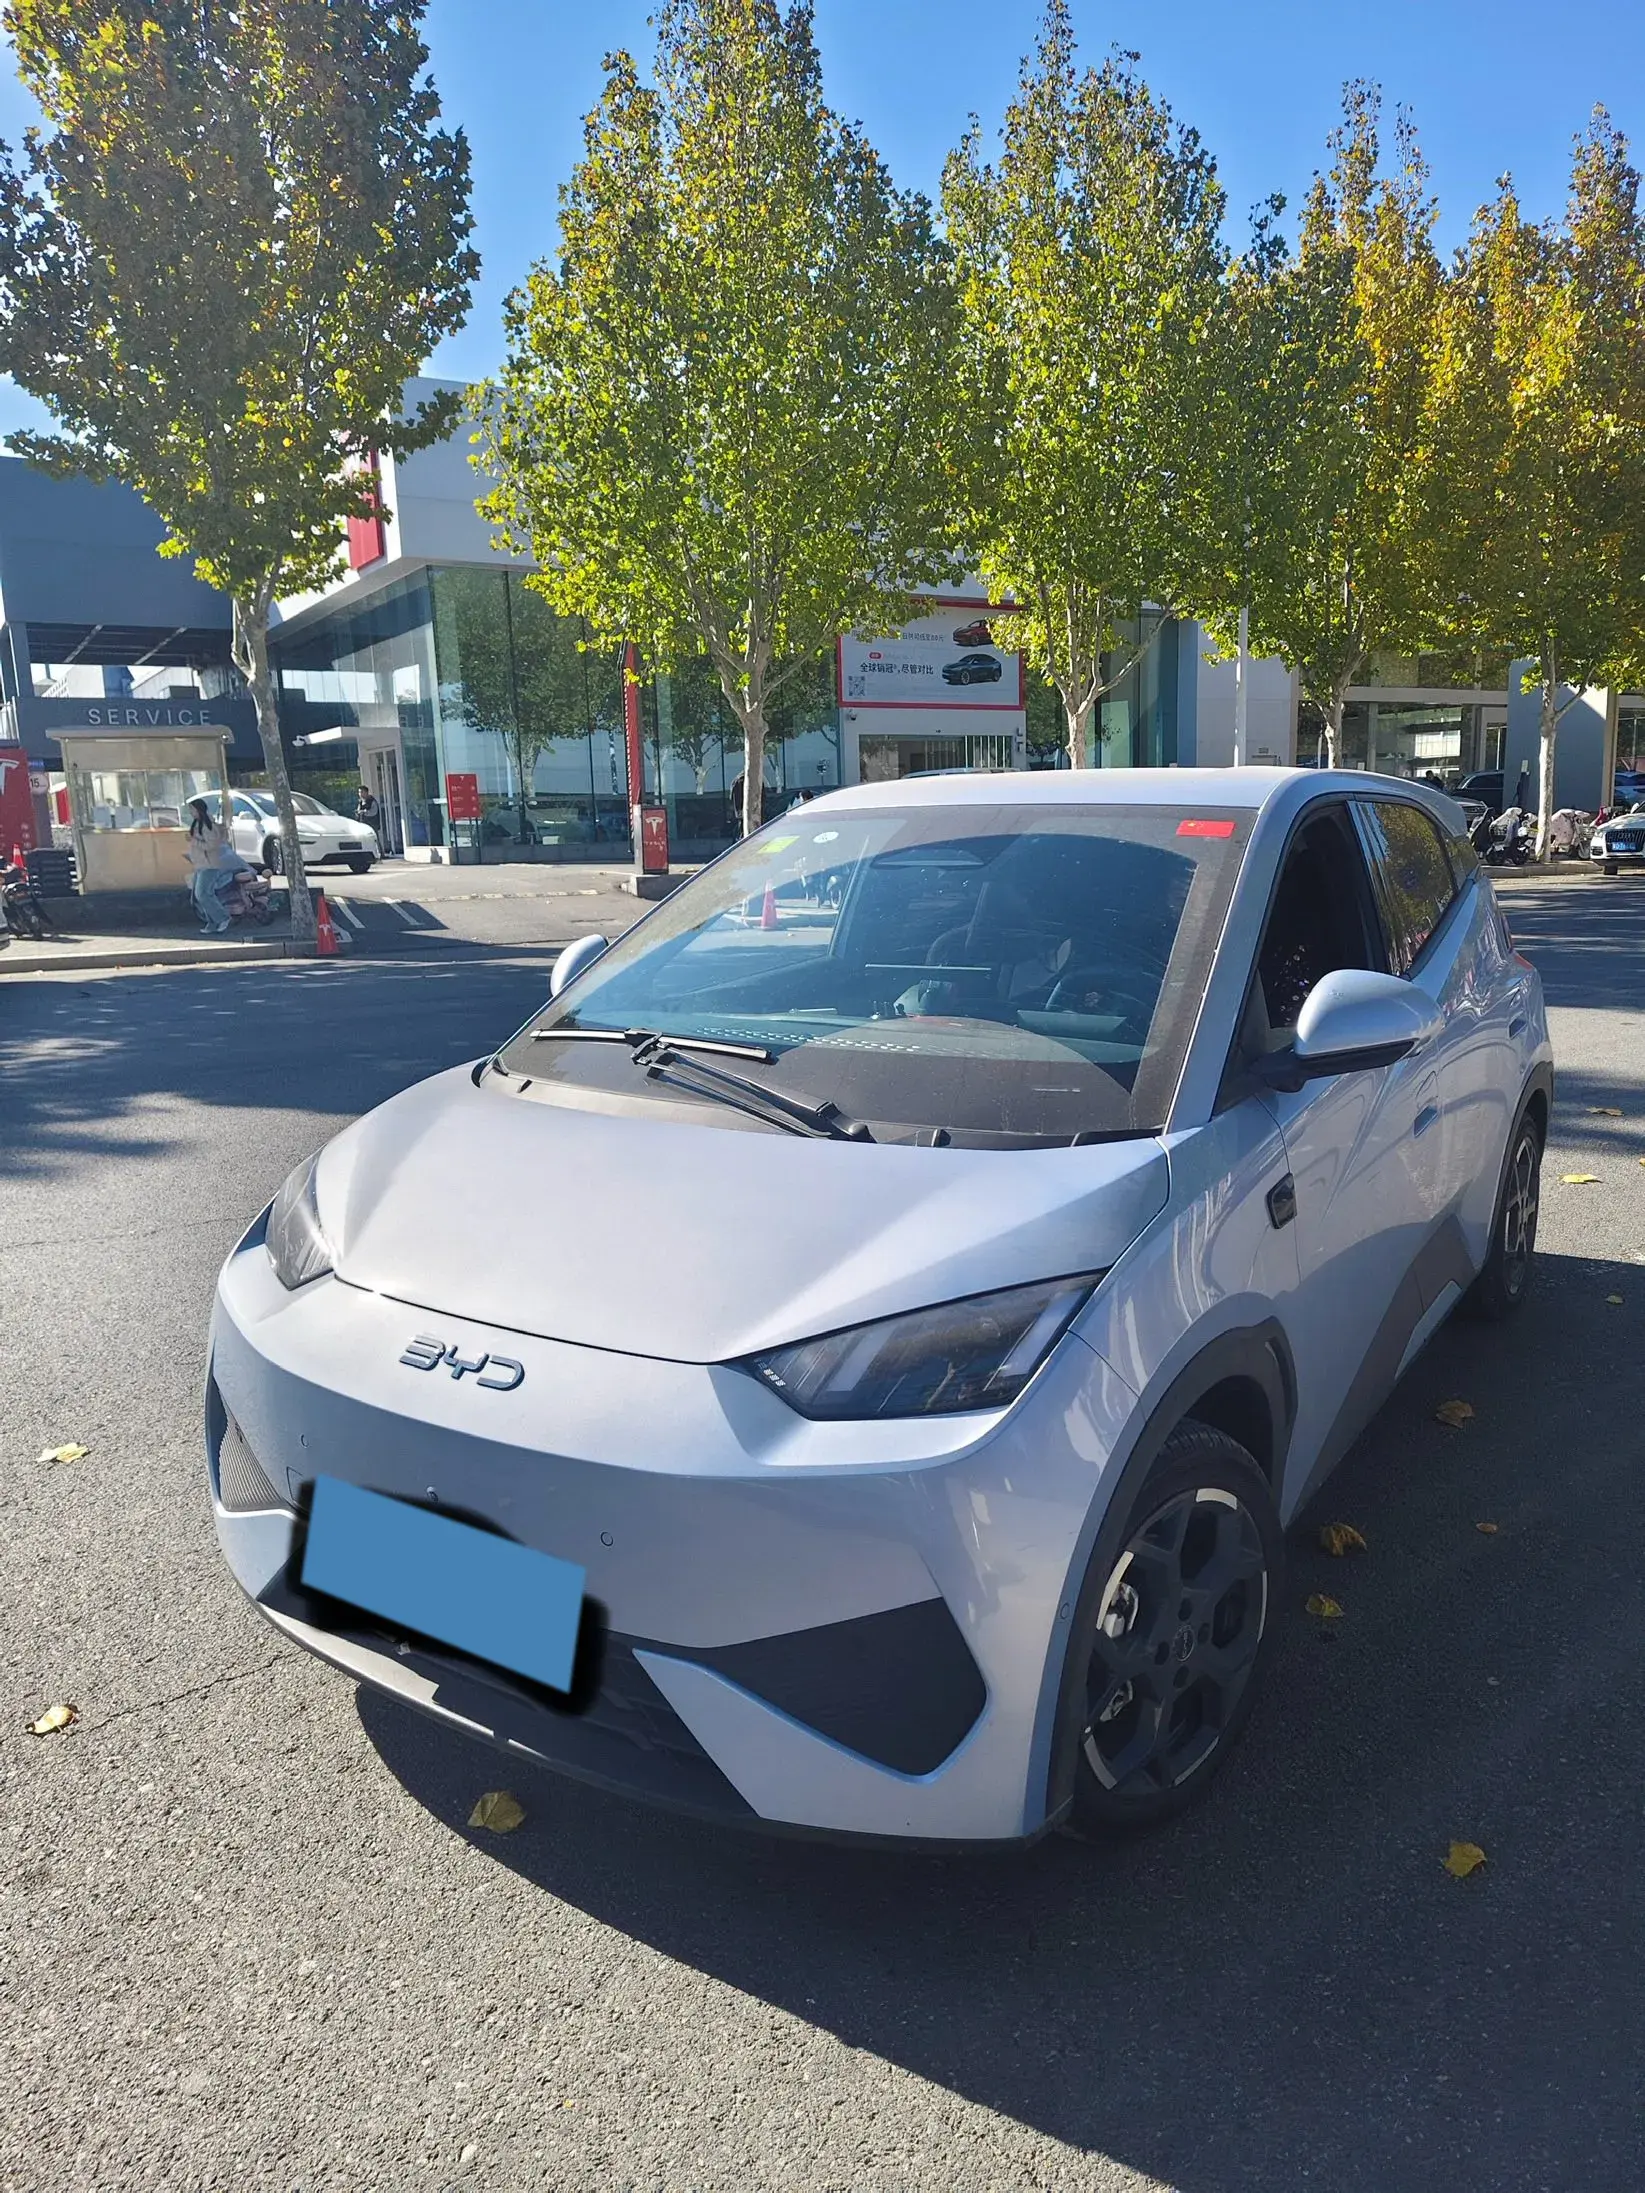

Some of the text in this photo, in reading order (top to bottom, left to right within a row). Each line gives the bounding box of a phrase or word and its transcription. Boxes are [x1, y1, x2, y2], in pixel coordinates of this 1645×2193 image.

[88, 708, 210, 725] SERVICE
[30, 777, 40, 788] 15
[399, 1334, 526, 1392] BYD
